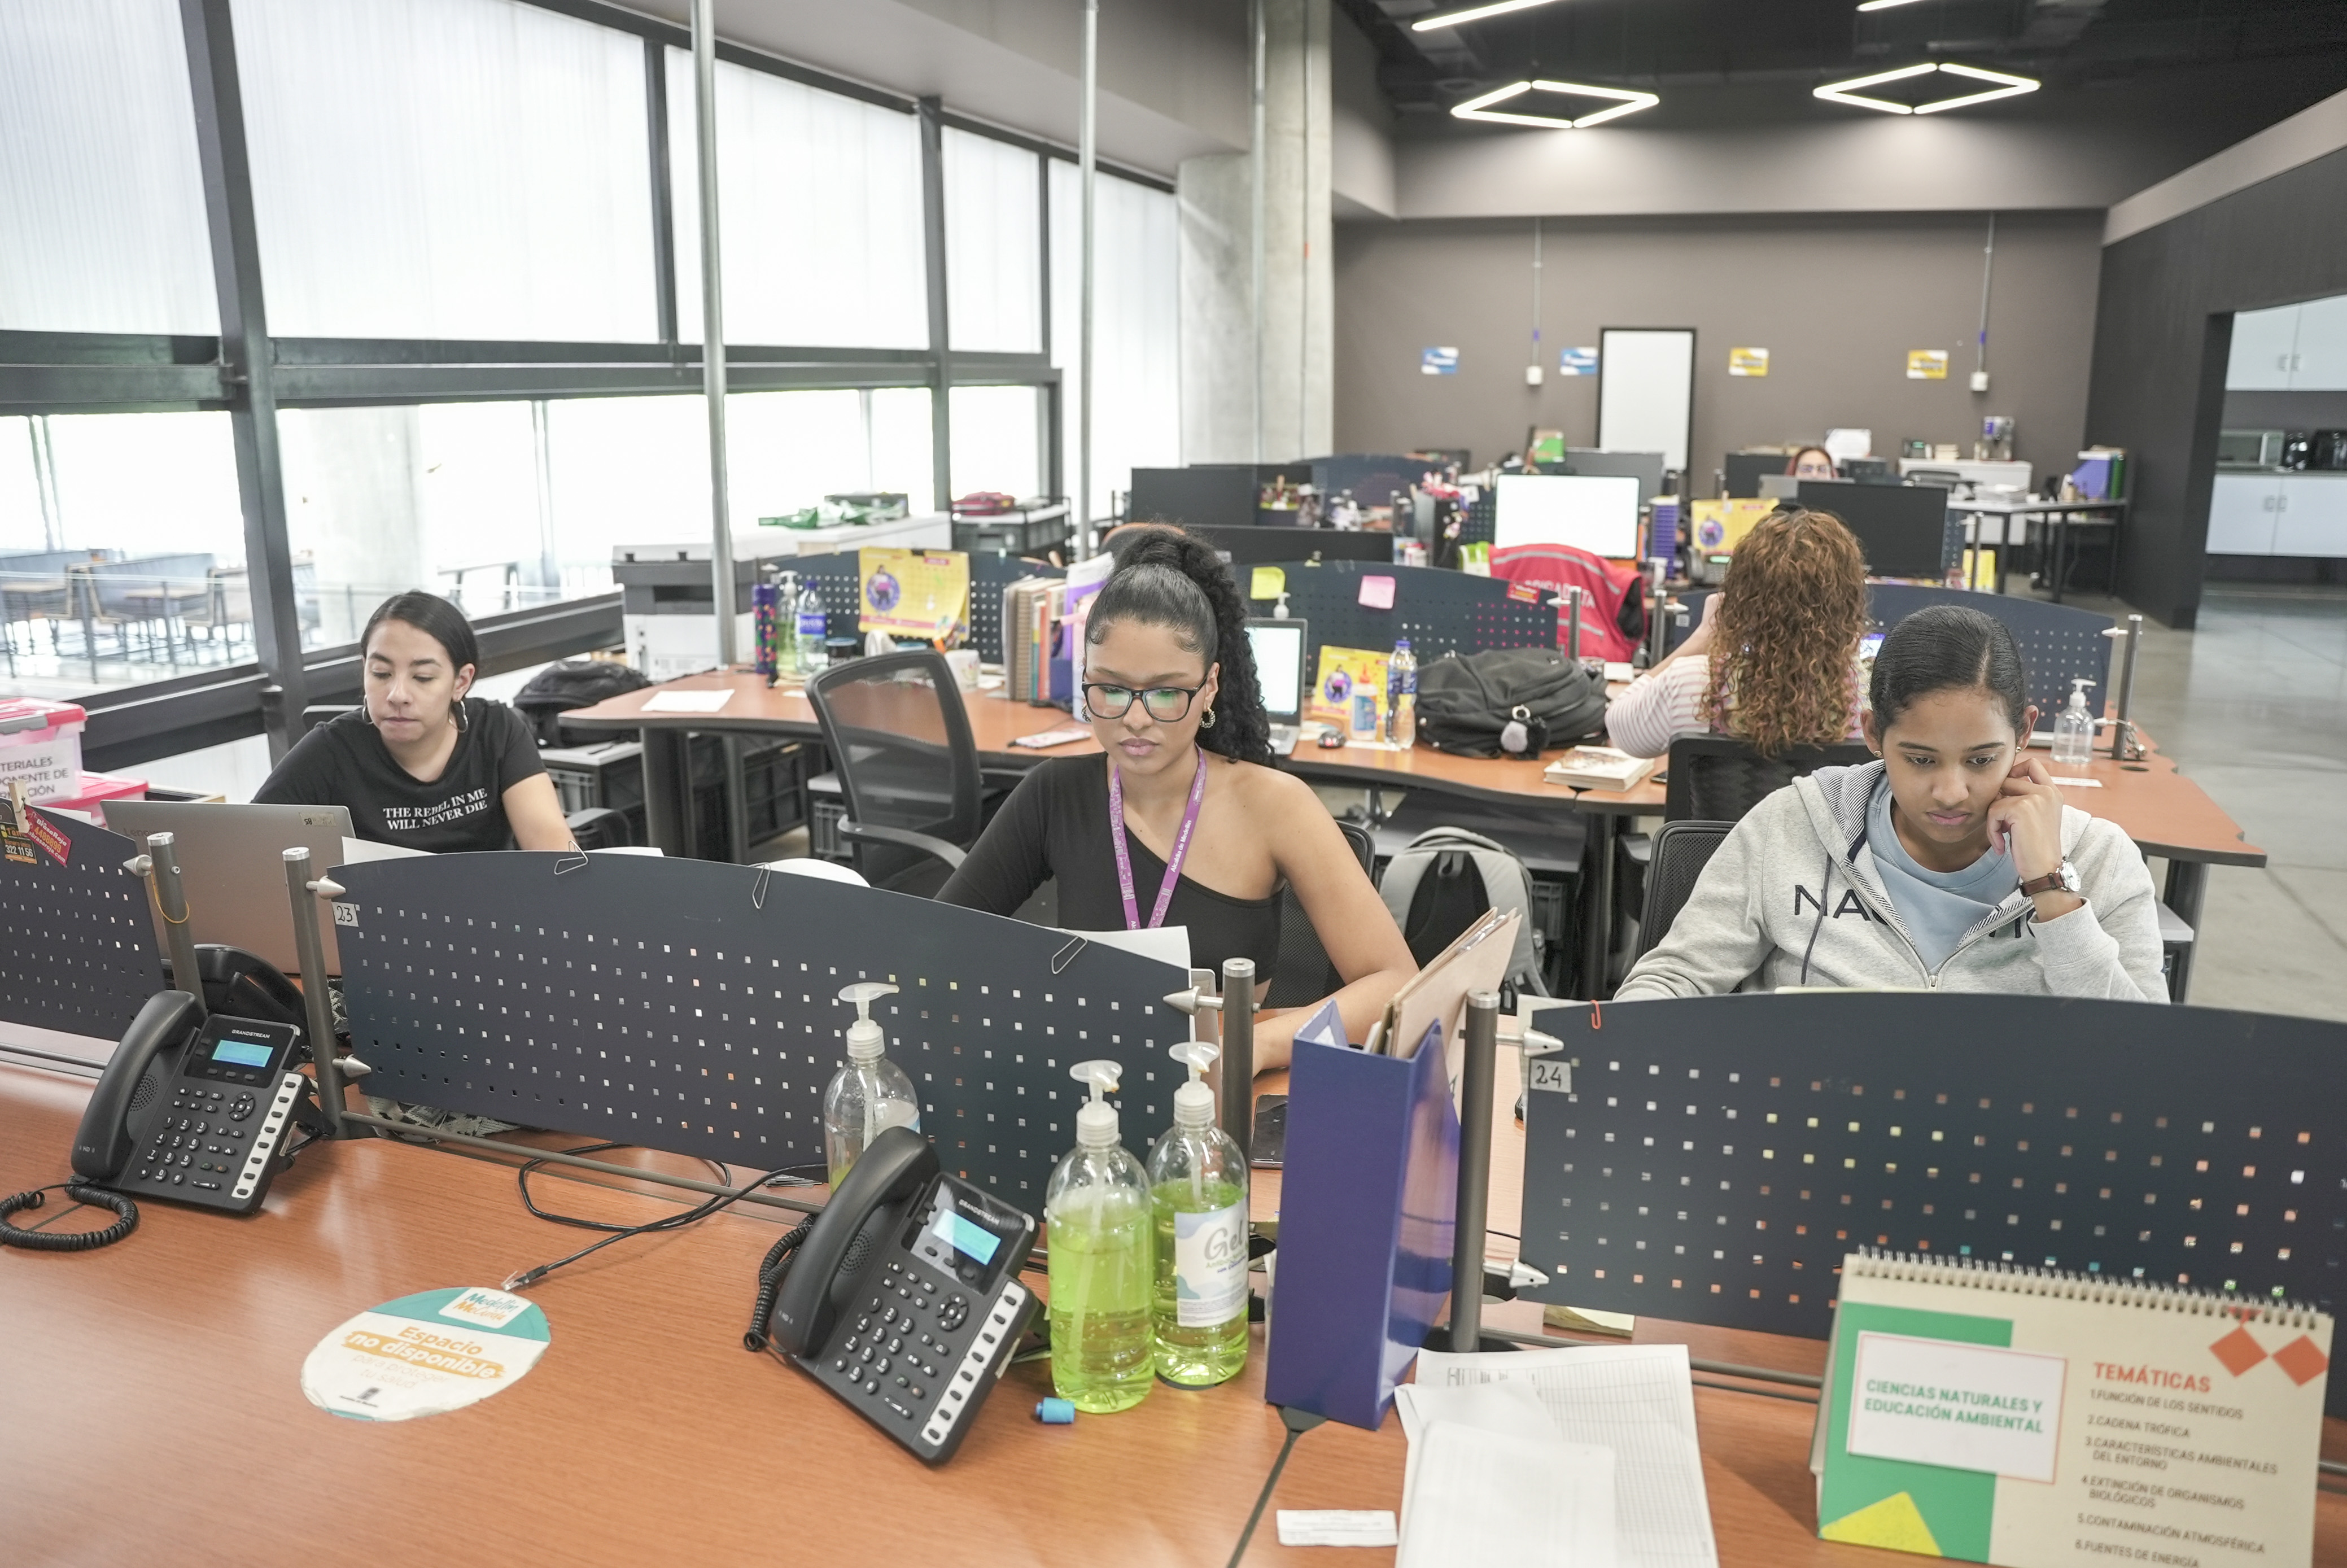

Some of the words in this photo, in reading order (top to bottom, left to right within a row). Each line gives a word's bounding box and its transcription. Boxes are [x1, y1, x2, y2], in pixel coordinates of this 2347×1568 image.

[0, 756, 53, 772] TERIALES
[0, 771, 50, 787] ONENTE
[54, 768, 68, 780] DE
[383, 807, 411, 818] THE
[414, 801, 450, 818] REBEL
[451, 794, 466, 807] IN
[467, 788, 487, 802] ME
[387, 819, 420, 830] WILL
[422, 807, 464, 827] NEVER
[465, 800, 487, 815] DIE
[5, 845, 18, 854] 322
[18, 846, 25, 855] 11
[25, 848, 33, 857] 56
[34, 827, 62, 853] 4488899
[337, 905, 353, 922] 23
[231, 1029, 270, 1038] GRANDSTREAM
[1536, 1064, 1561, 1088] 24
[1204, 1220, 1243, 1260] Gel
[398, 1326, 482, 1355] Espacio
[349, 1334, 380, 1348] no
[381, 1340, 496, 1378] disponible
[351, 1355, 386, 1368] para
[387, 1362, 451, 1384] proteger
[360, 1368, 374, 1378] tu
[378, 1373, 418, 1389] salud
[2093, 1361, 2211, 1393] TEMÁTICAS
[1867, 1379, 1935, 1399] CIENCIAS
[1939, 1388, 2029, 1412] NATURALES
[2034, 1400, 2043, 1413] Y
[2147, 1396, 2160, 1408] DE
[2163, 1398, 2184, 1412] LOS
[2187, 1402, 2243, 1420] SENTIDOS
[1865, 1398, 1951, 1421] EDUCACIÓN
[1956, 1410, 2043, 1433] AMBIENTAL
[2144, 1420, 2191, 1438] TRÓFICA
[2092, 1449, 2112, 1462] DEL
[2114, 1453, 2168, 1470] ENTORNO
[2197, 1452, 2278, 1475] AMBIENTALES
[2089, 1488, 2156, 1508] BIOLÓGICOS
[2149, 1484, 2164, 1496] DE
[2166, 1488, 2245, 1510] ORGANISMOS
[2182, 1530, 2266, 1553] ATMOSFÉRICA
[2134, 1548, 2148, 1560] DE
[2151, 1552, 2199, 1568] ENERGÍA
